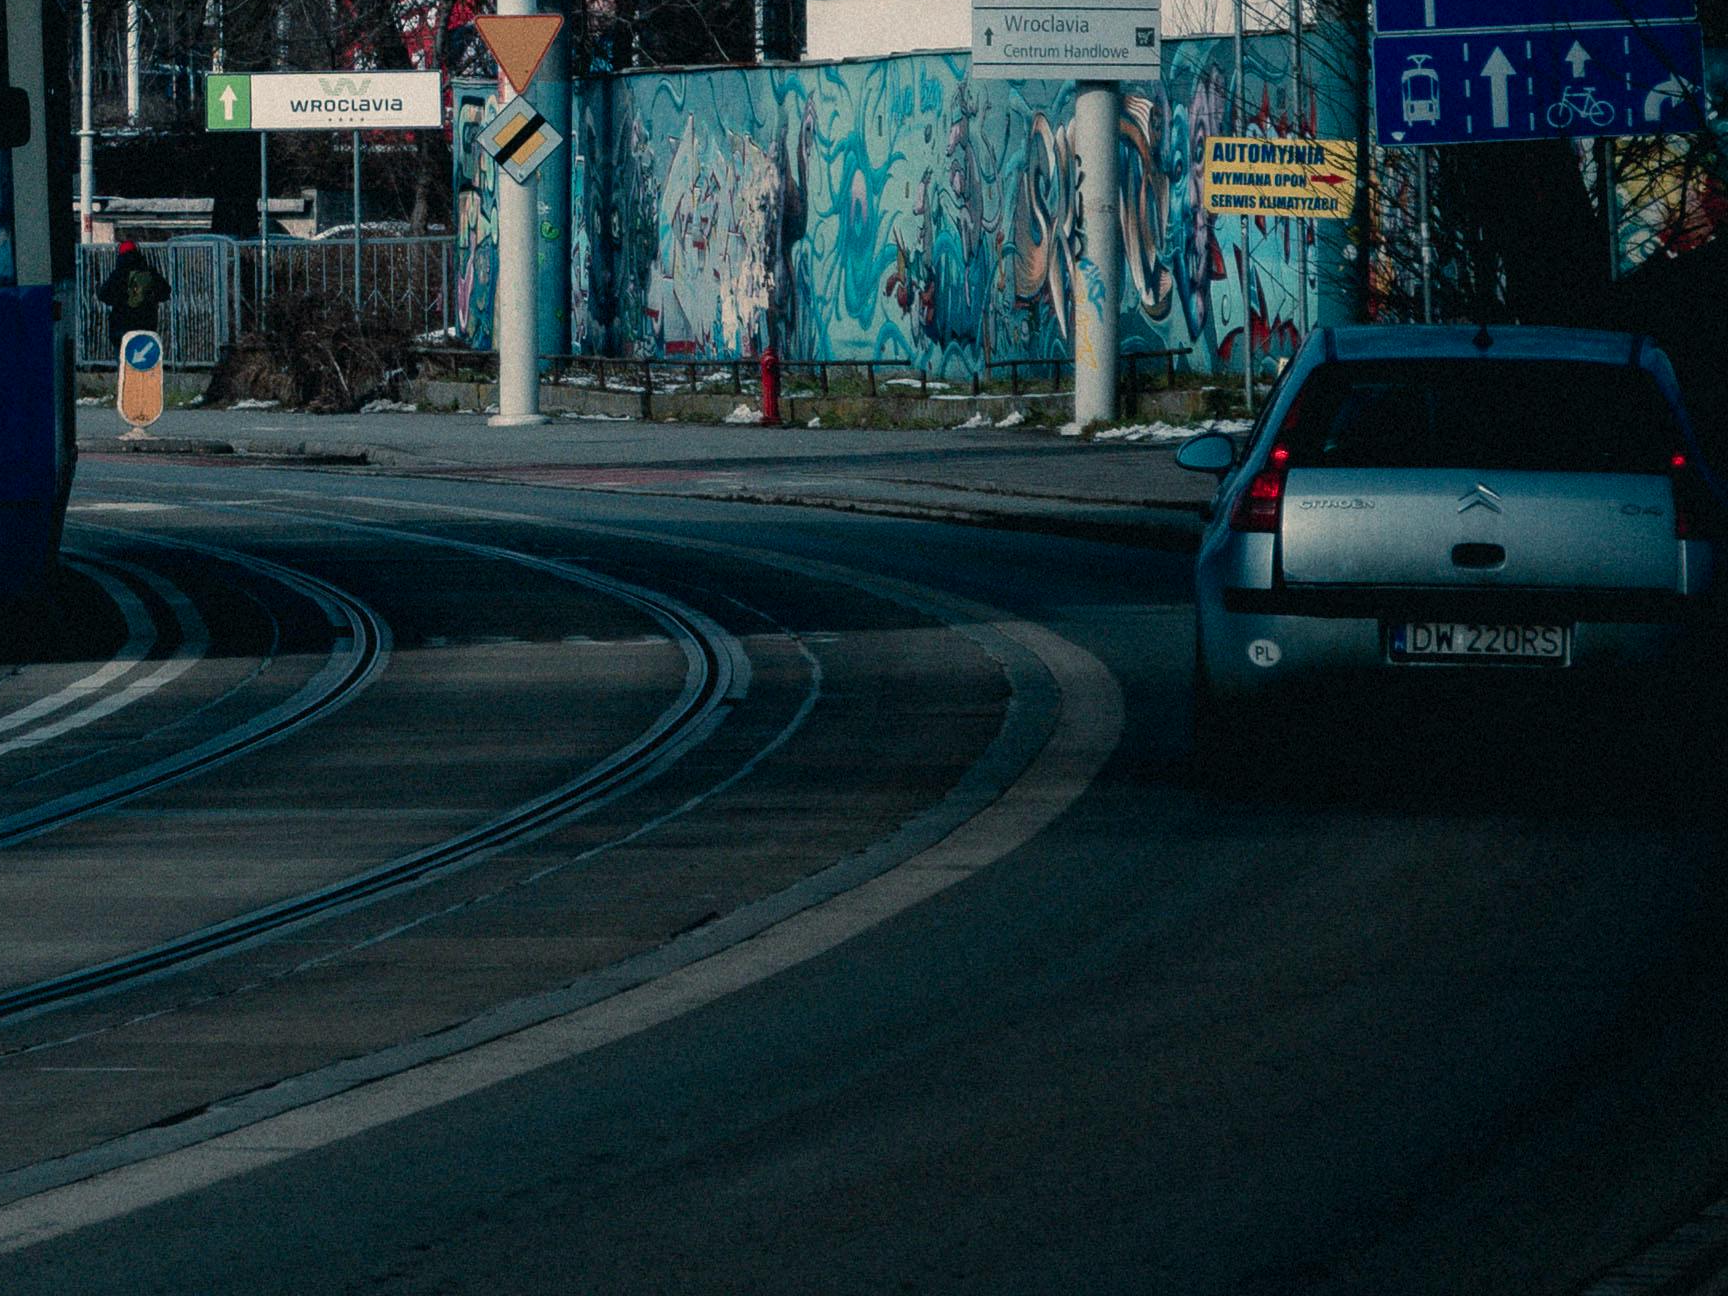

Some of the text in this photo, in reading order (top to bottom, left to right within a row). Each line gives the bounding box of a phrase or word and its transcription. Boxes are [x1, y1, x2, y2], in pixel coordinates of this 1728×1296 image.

[1003, 15, 1090, 33] Wroclavia
[1003, 43, 1130, 59] Centrum Handlowe
[1212, 142, 1326, 166] AUTOMYJNIA
[1212, 171, 1308, 188] WYMIANA OPON
[1211, 194, 1257, 209] SERWIS
[1412, 623, 1560, 655] DW 220RS
[1254, 644, 1275, 662] PL
